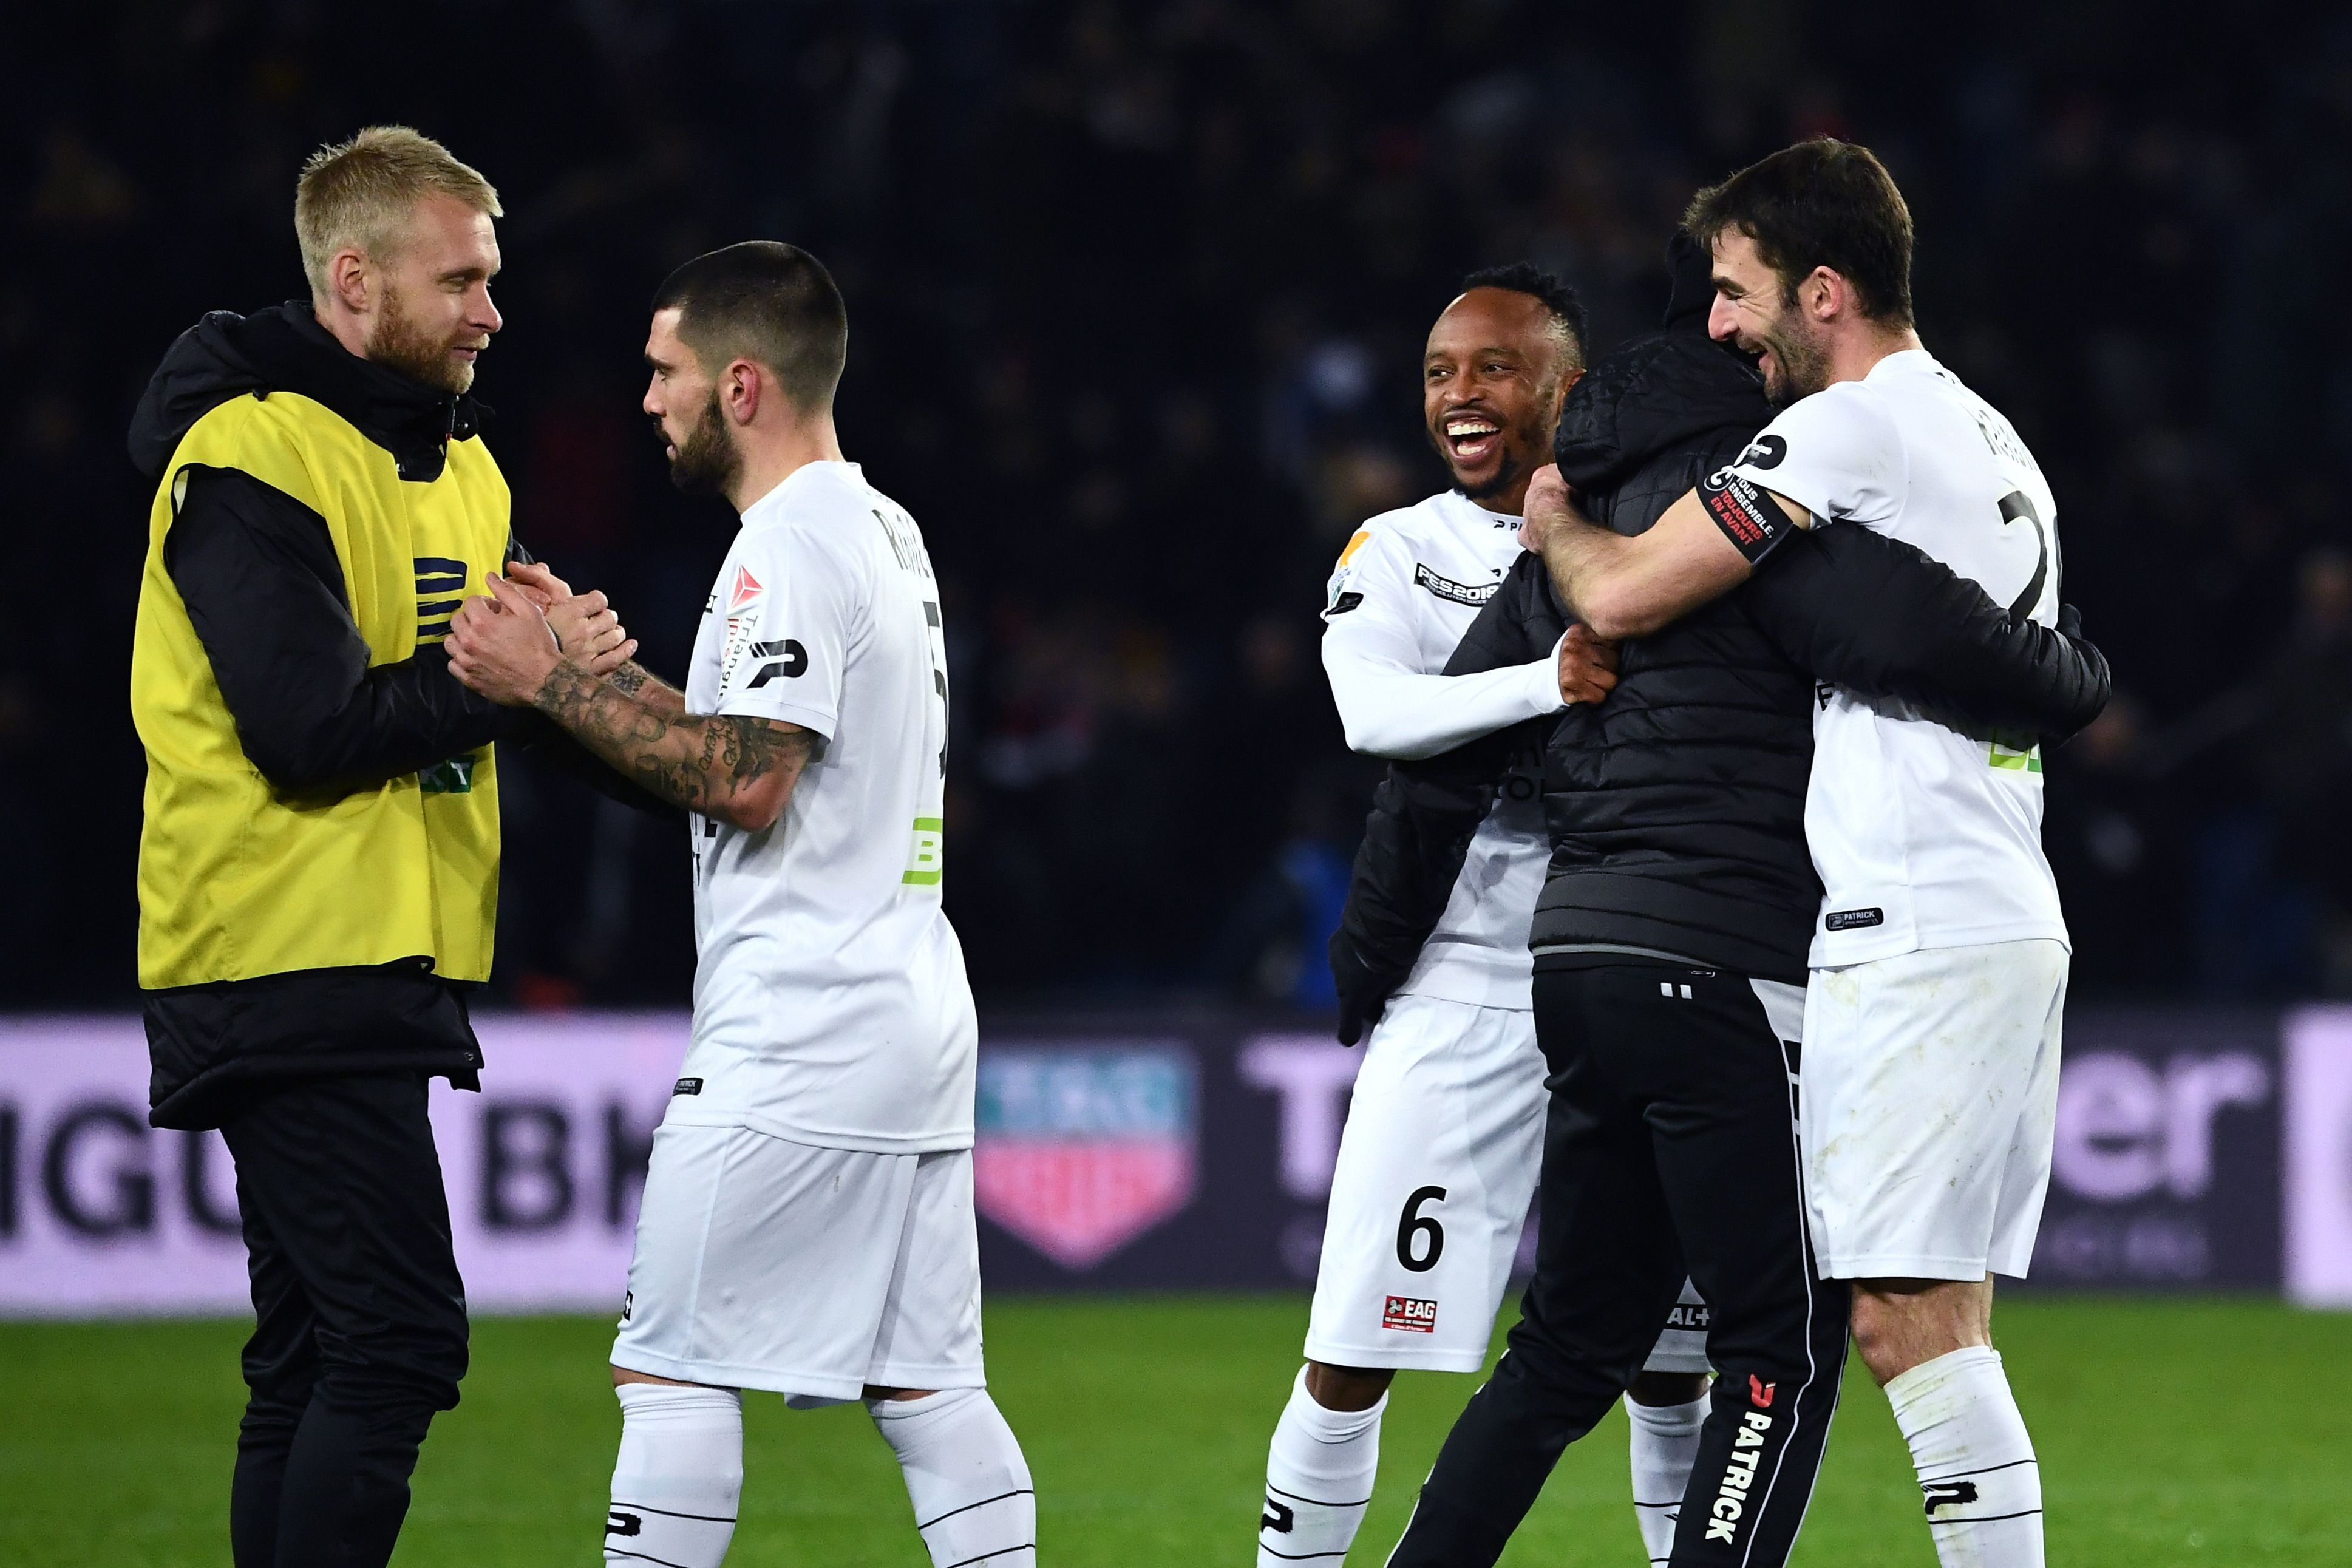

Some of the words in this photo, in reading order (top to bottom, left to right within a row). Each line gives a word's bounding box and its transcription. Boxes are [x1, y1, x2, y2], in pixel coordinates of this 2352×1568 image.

[1710, 496, 1725, 512] EN
[1721, 511, 1754, 545] AVANT
[1719, 489, 1763, 540] TOUJOURS
[1728, 481, 1775, 540] ENSEMBLE,
[1844, 910, 1875, 920] PATRICK
[1396, 1185, 1447, 1272] 6
[1404, 1300, 1436, 1319] EAG
[1704, 1411, 1773, 1546] PATRICK
